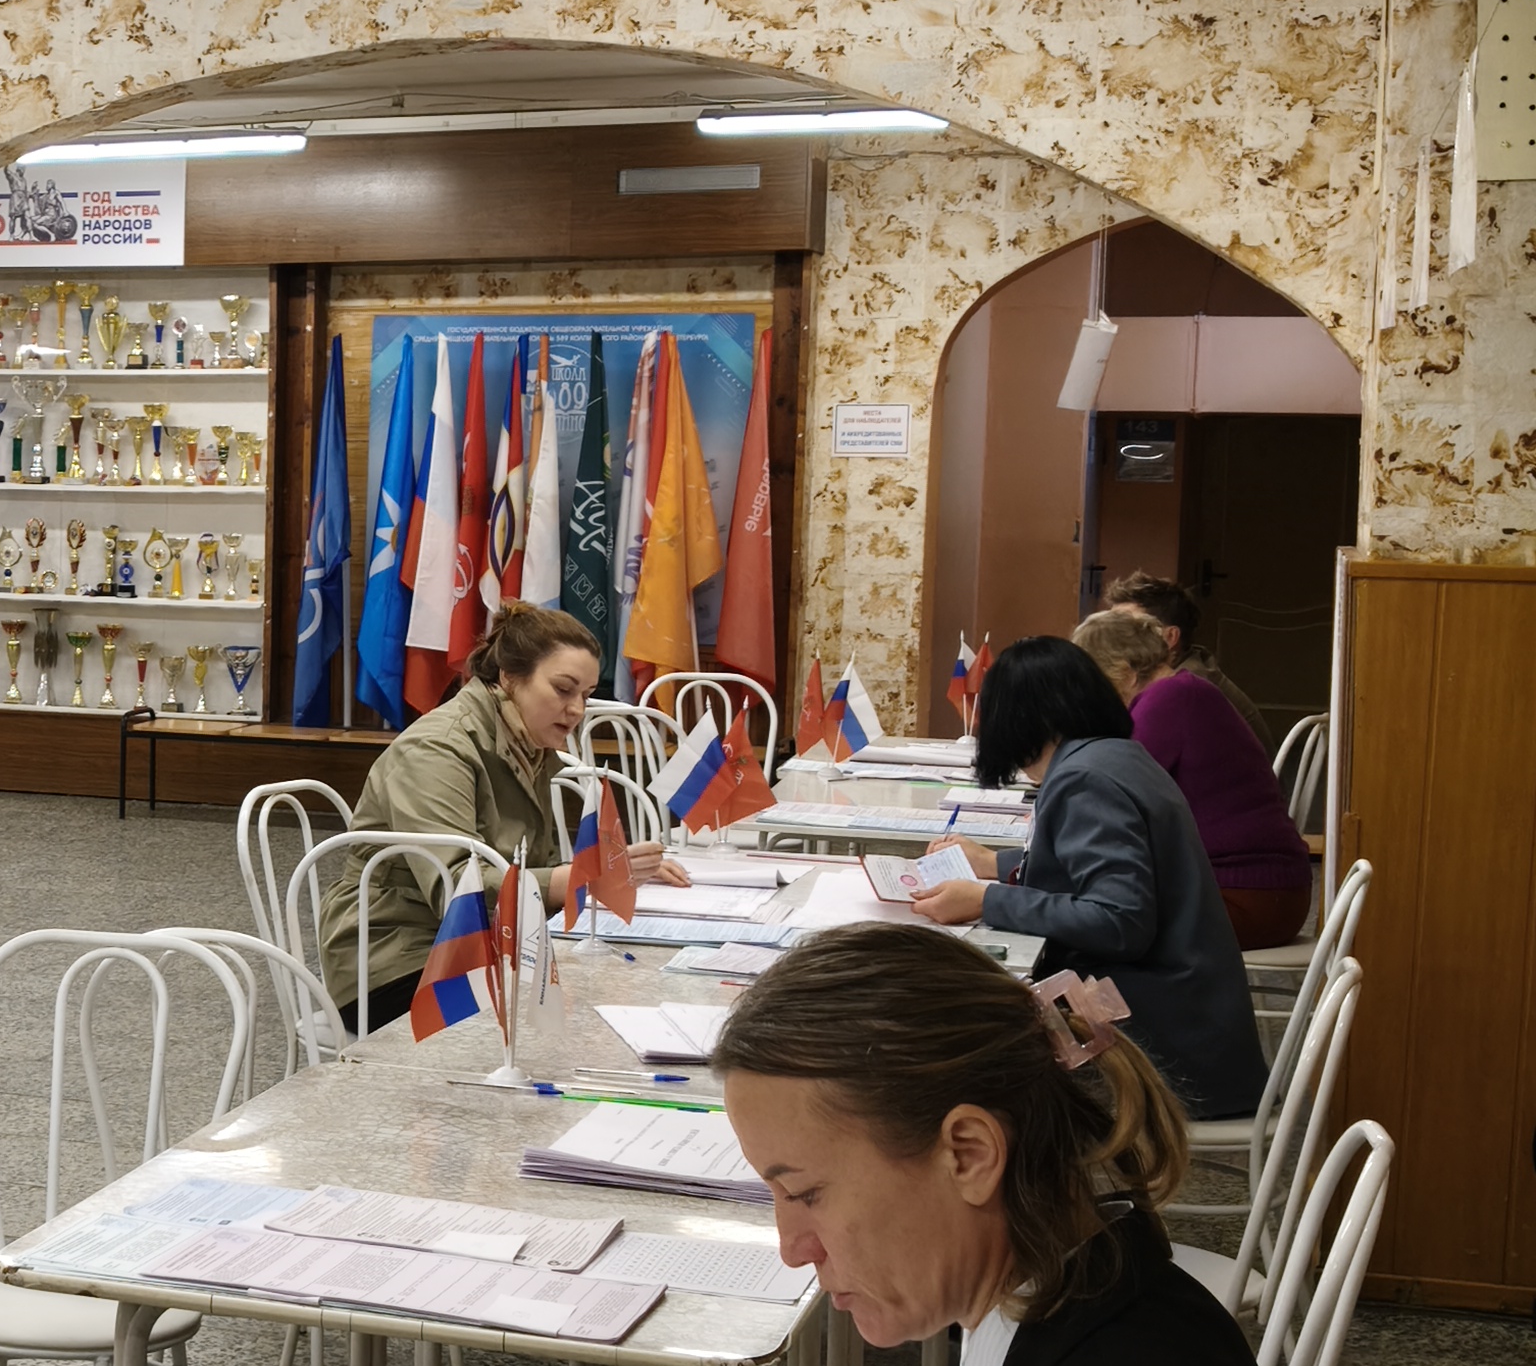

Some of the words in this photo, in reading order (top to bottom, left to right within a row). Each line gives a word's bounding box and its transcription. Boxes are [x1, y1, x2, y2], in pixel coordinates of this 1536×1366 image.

[83, 191, 111, 205] ГОД
[82, 204, 160, 218] ЕДИНСТВА
[82, 219, 152, 232] НАРОДОВ
[82, 233, 143, 245] РОССИИ
[552, 367, 586, 382] ШКОЛА
[558, 382, 587, 410] 89
